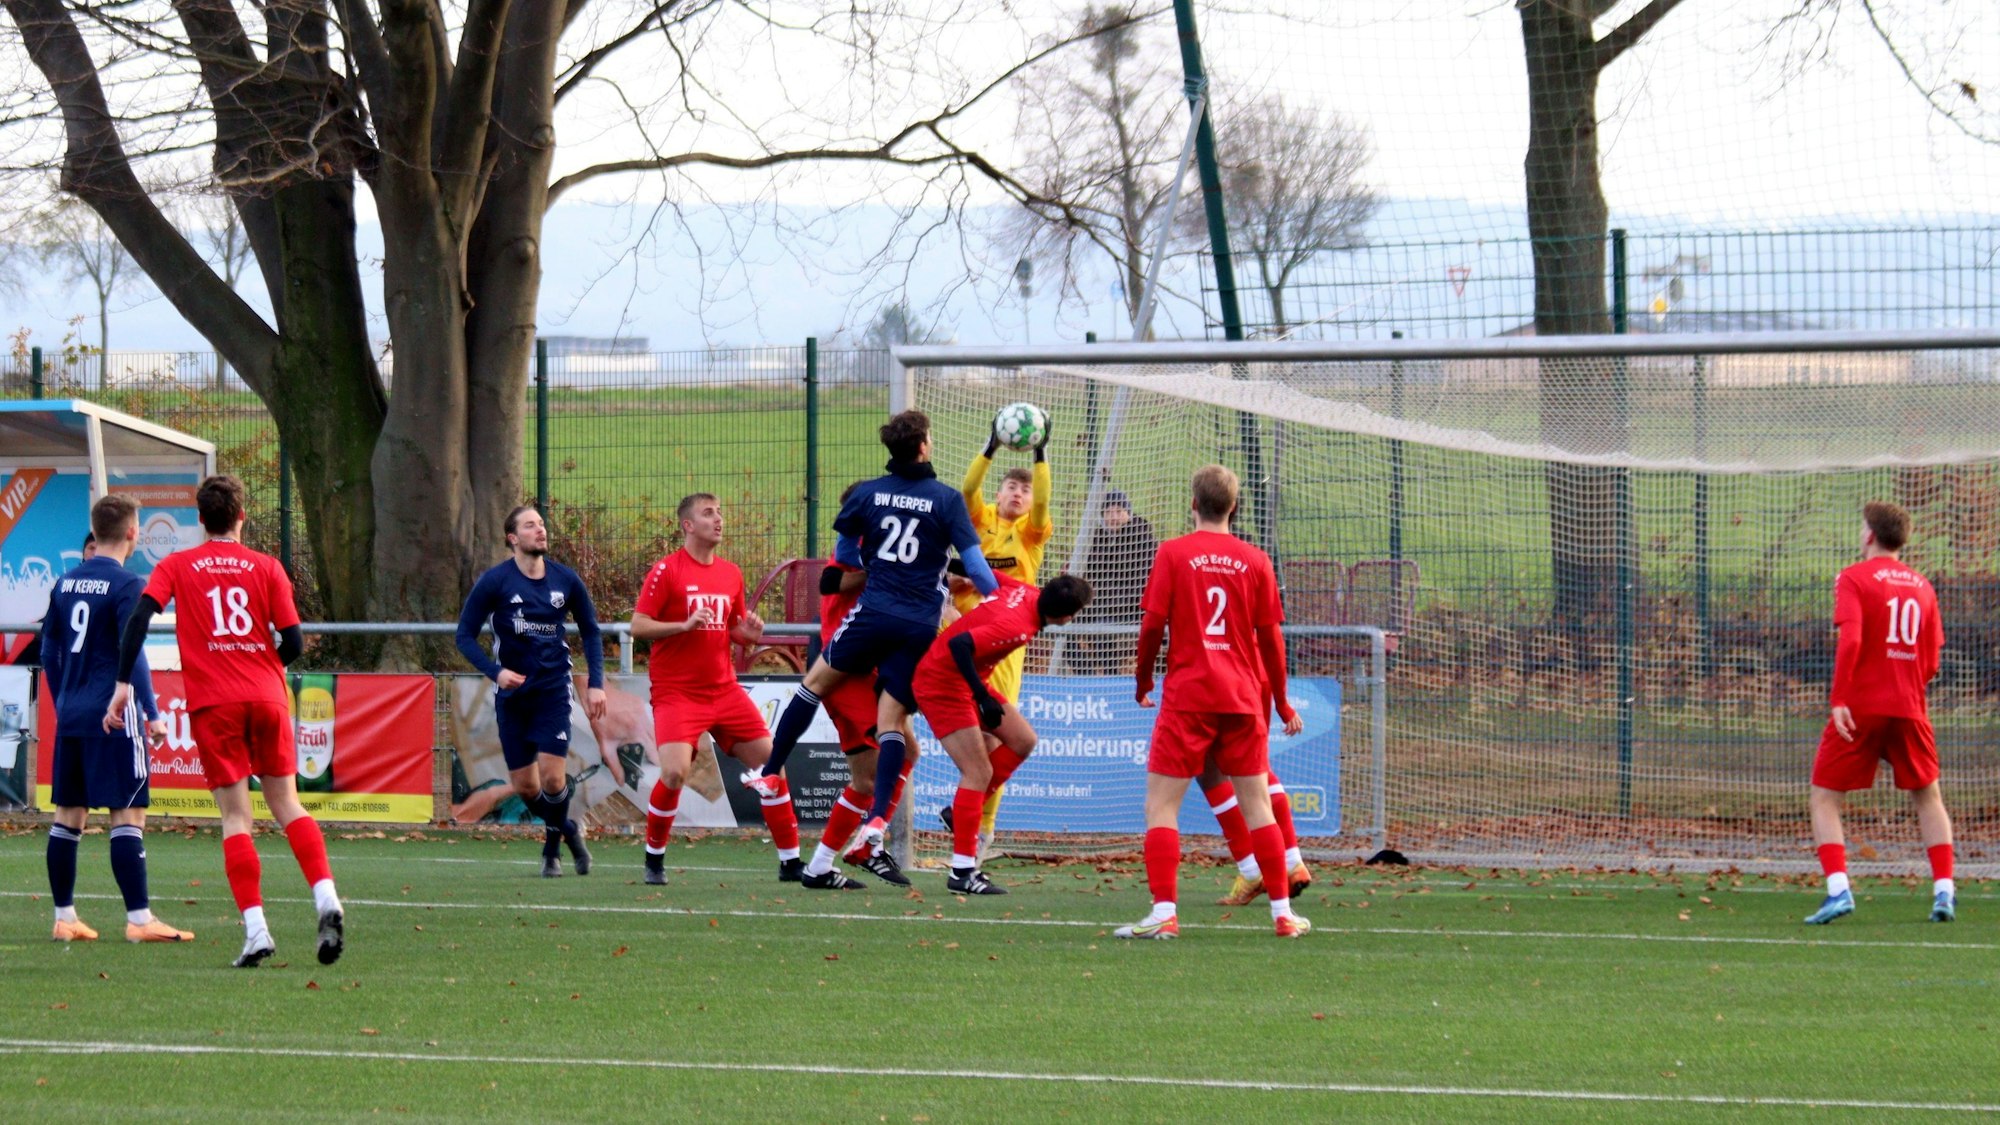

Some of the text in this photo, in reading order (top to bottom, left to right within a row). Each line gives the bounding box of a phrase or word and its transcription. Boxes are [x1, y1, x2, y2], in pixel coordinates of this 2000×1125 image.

[1, 477, 27, 520] VIP
[874, 493, 933, 513] BW KERPEN
[877, 515, 920, 564] 26
[61, 579, 111, 596] BW KERPEN
[71, 600, 90, 654] 9
[206, 586, 254, 637] 18
[1205, 586, 1228, 636] 2
[1885, 596, 1922, 646] 10
[1029, 694, 1114, 725] Projekt.
[820, 773, 843, 782] 53949
[1049, 783, 1092, 797] kaufen!
